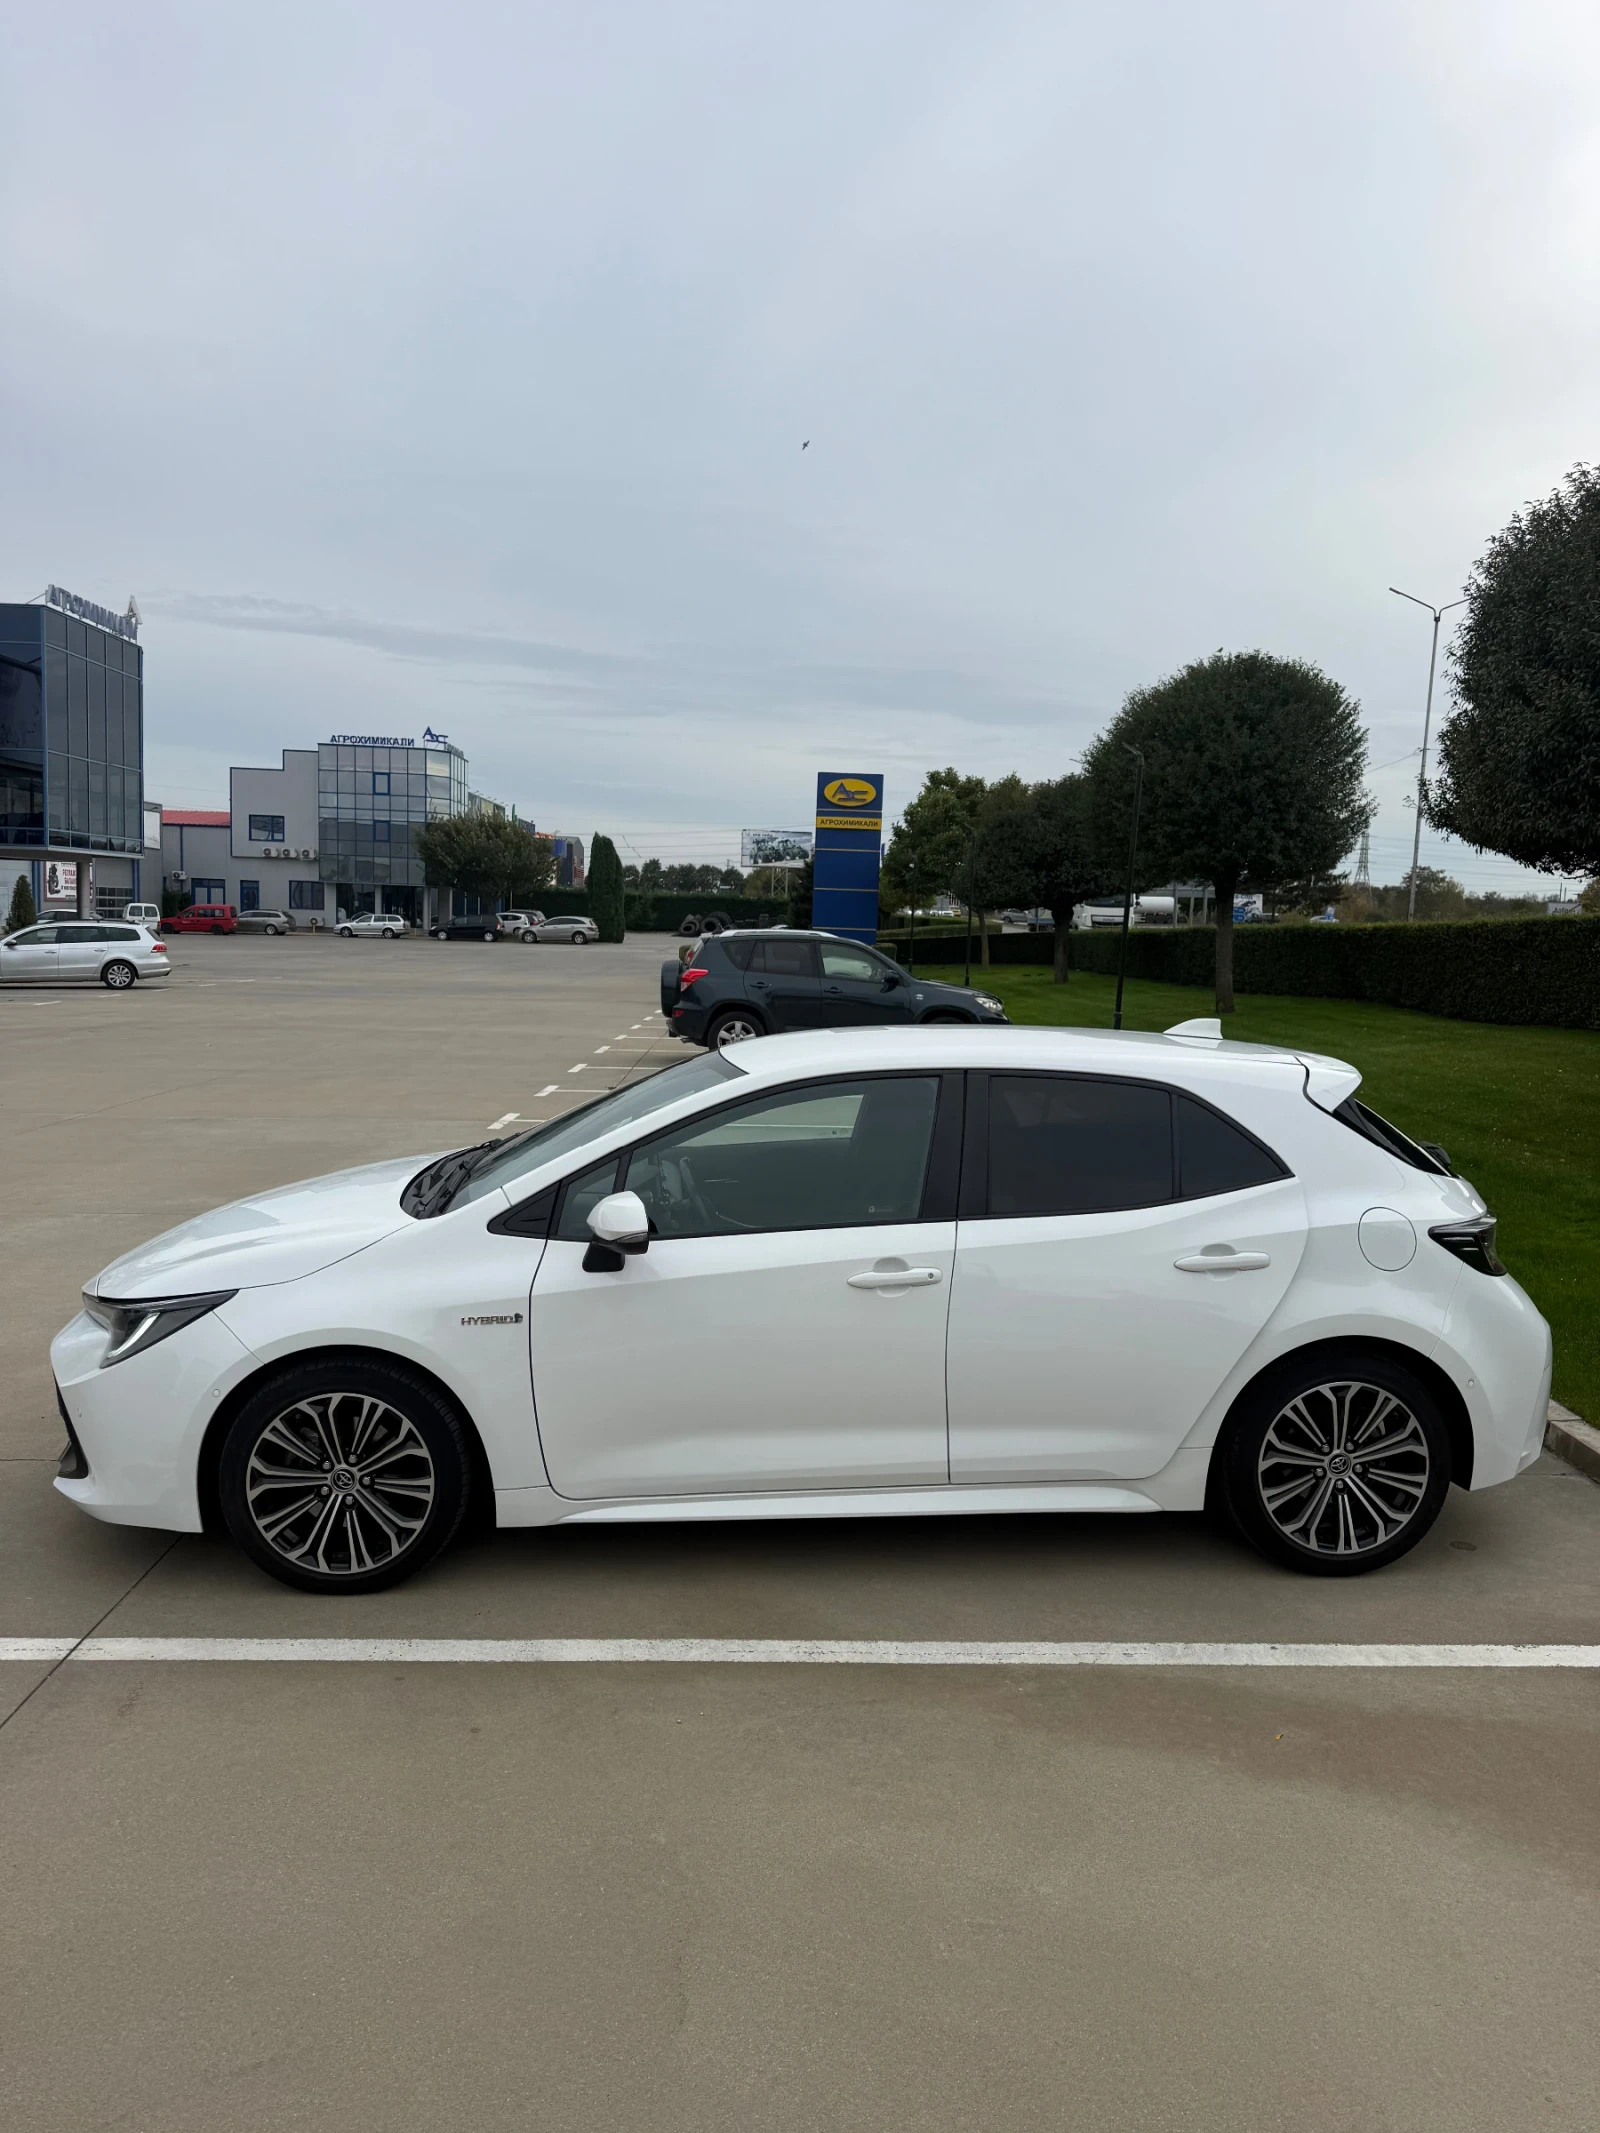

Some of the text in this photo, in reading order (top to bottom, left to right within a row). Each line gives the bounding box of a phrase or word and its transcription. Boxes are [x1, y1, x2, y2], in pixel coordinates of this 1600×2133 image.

[330, 735, 415, 747] АГРОХИМИКАЛИ
[820, 819, 878, 827] АГРОХИМИКАЛИ
[461, 1315, 513, 1326] HYBRID
